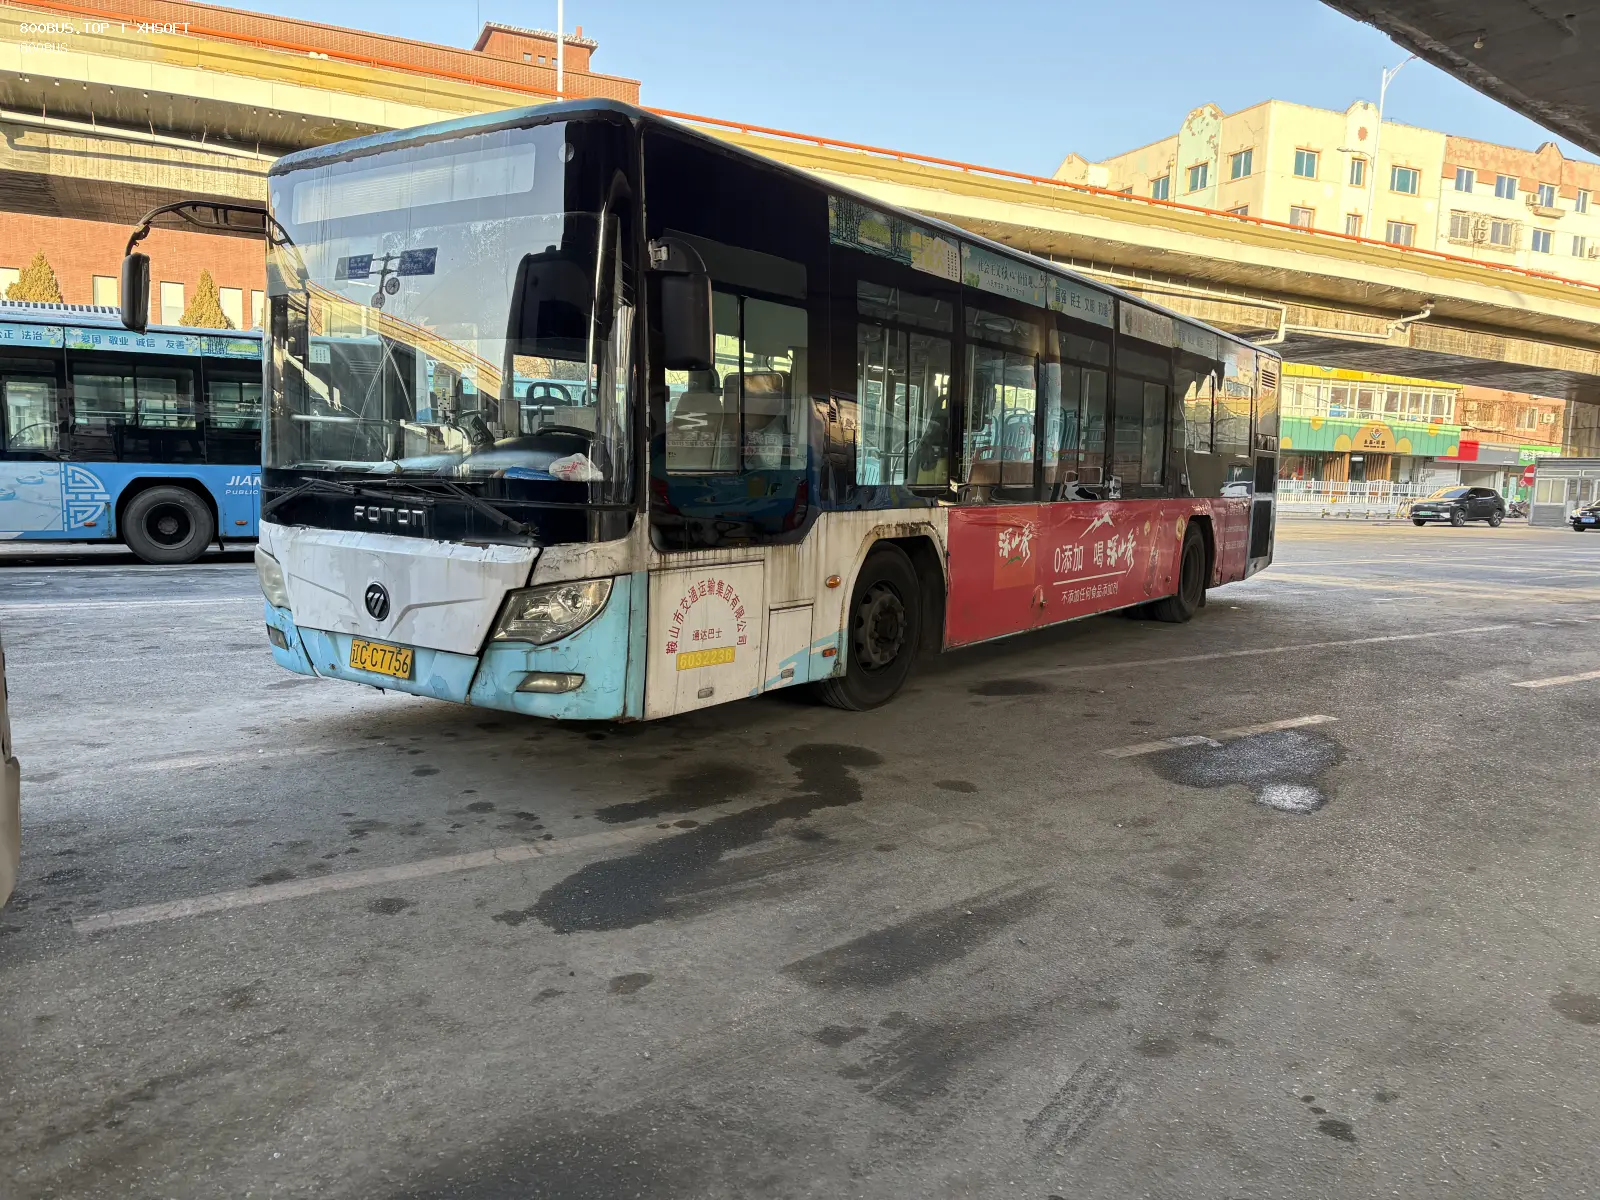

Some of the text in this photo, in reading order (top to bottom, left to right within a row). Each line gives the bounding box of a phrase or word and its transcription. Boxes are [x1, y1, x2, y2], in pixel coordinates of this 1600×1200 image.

[21, 330, 43, 341] 法治
[81, 334, 186, 350] 爱国 敬业 诚信 友善
[353, 505, 426, 527] FOTON
[679, 648, 732, 668] 6032236
